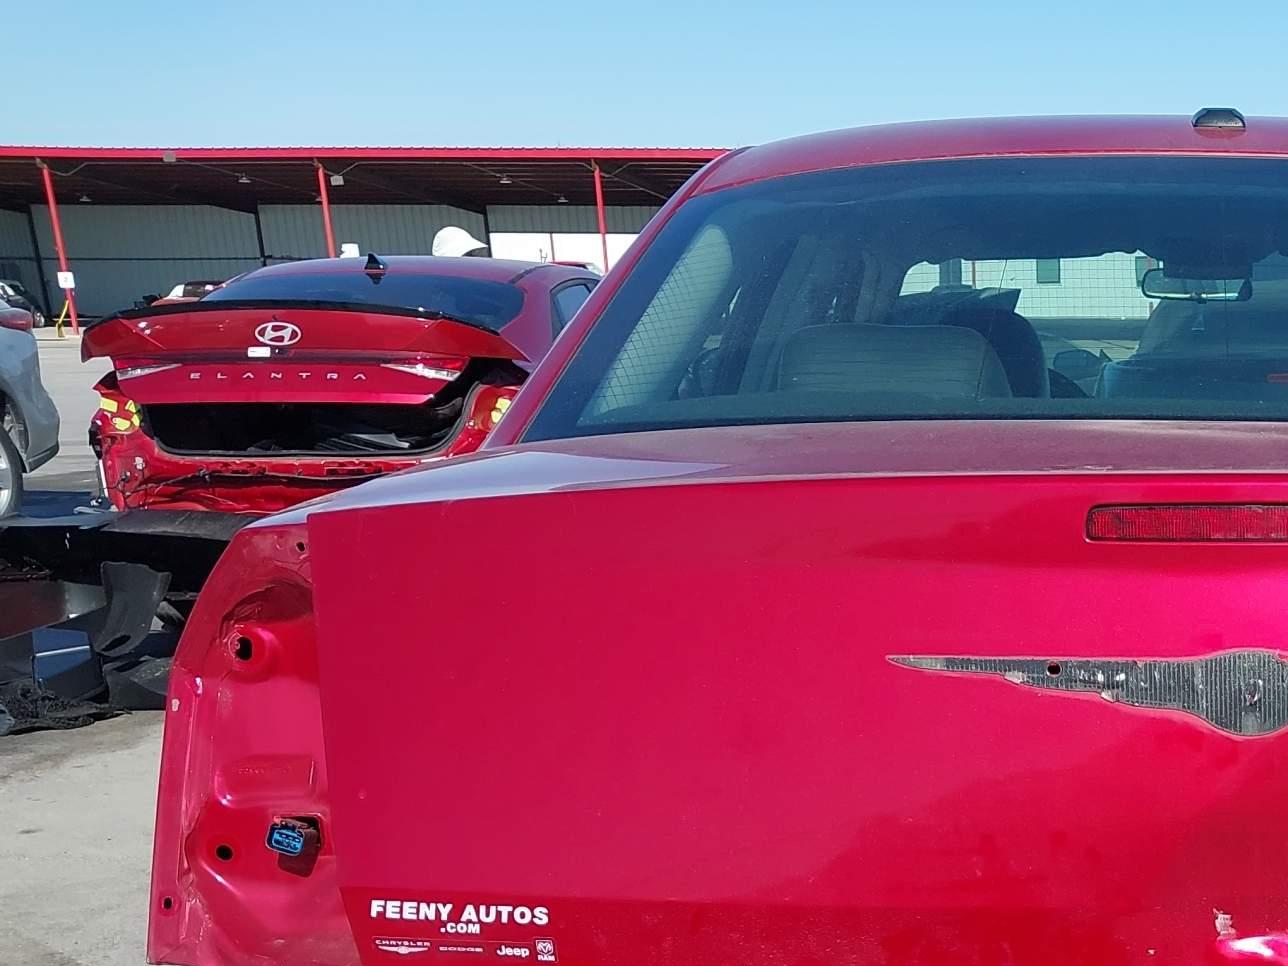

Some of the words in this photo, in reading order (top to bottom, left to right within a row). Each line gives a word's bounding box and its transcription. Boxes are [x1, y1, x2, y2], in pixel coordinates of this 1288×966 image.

[190, 372, 366, 380] ELANTRA
[370, 899, 453, 921] FEENY
[461, 904, 549, 925] AUTOS
[440, 922, 481, 934] .COM
[375, 939, 431, 947] CHRYSLER
[496, 945, 530, 958] Jeep
[537, 954, 556, 962] RAM
